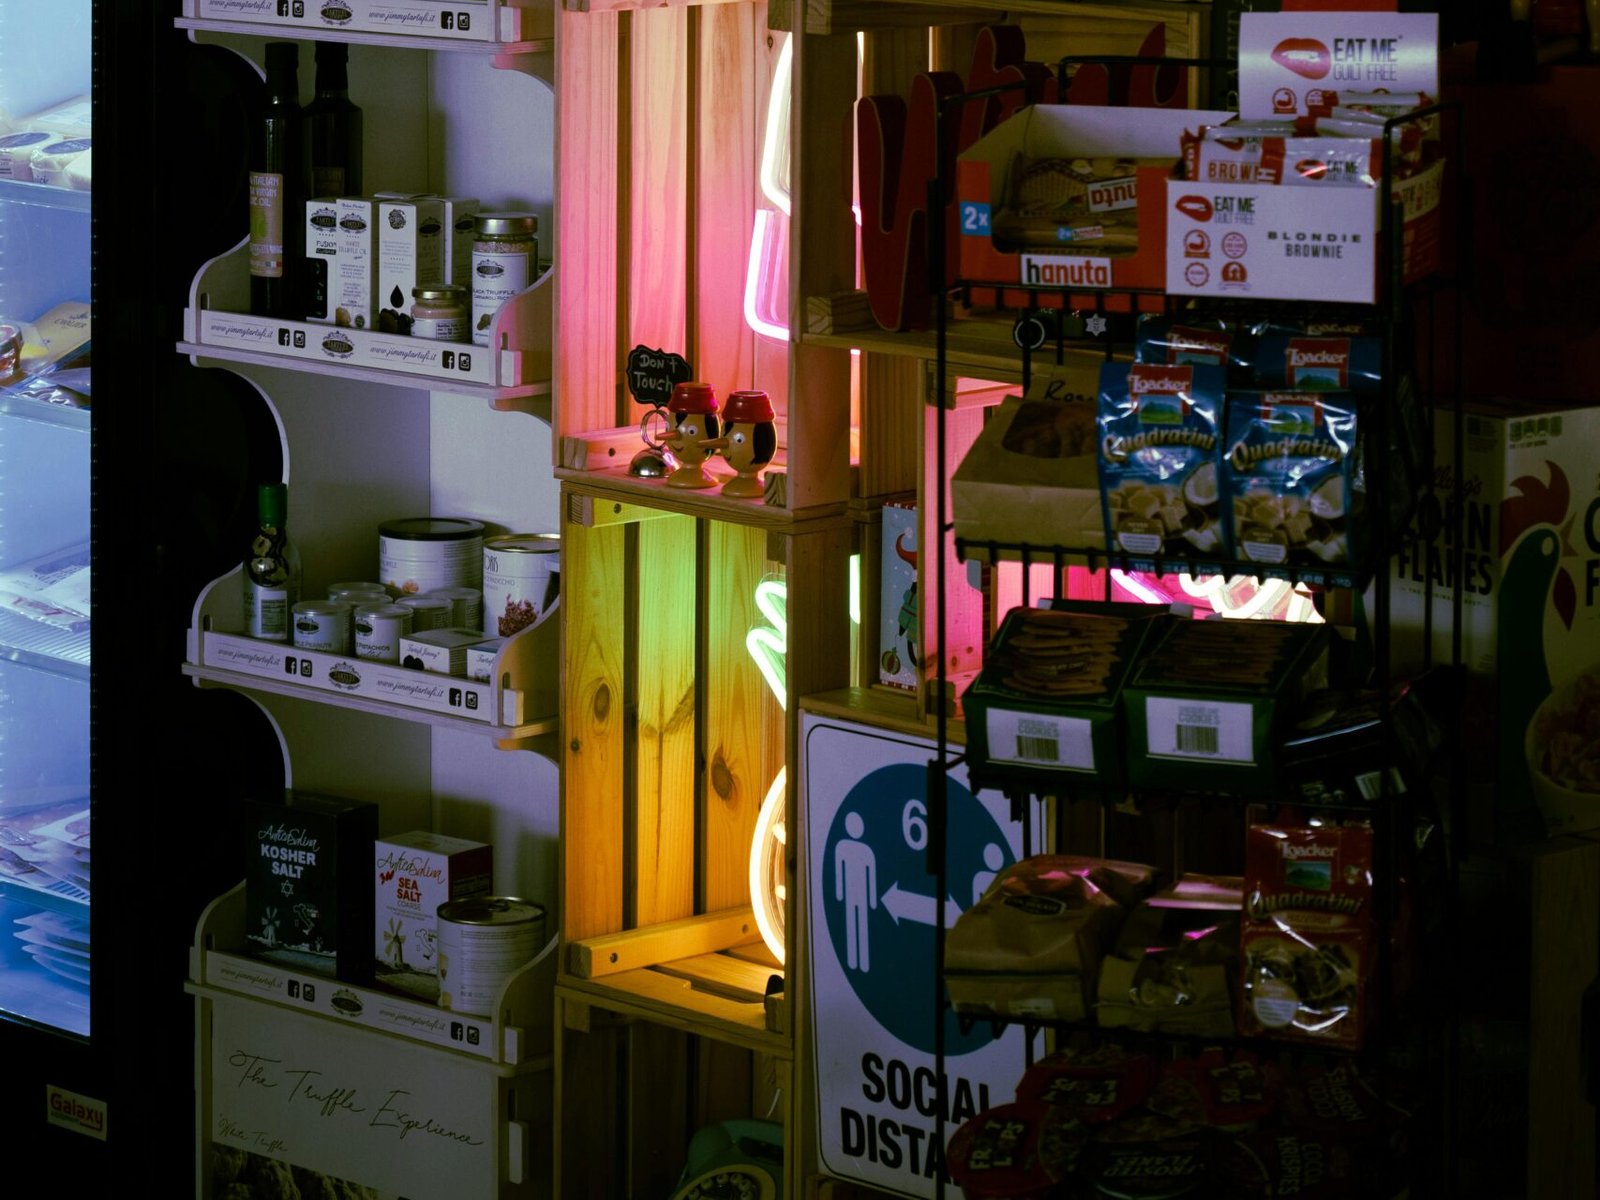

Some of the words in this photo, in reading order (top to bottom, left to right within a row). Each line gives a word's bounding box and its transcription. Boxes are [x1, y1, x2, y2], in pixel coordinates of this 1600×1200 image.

[1334, 38, 1366, 62] EAT
[1371, 38, 1397, 63] ME
[1333, 63, 1363, 81] GUILT
[1367, 63, 1397, 81] FREE
[1214, 196, 1234, 212] EAT
[1237, 196, 1255, 213] ME
[963, 205, 989, 230] 2x
[1267, 231, 1362, 243] BLONDIE
[1285, 243, 1343, 259] BROWNIE
[1026, 257, 1108, 285] hanuta
[1284, 347, 1347, 366] Loacker
[633, 371, 673, 394] Touch
[1127, 373, 1191, 394] Loacker
[1102, 425, 1216, 464] Quadratini
[260, 843, 317, 867] KOSHER
[1275, 840, 1339, 859] Loacker
[271, 860, 304, 880] SALT
[398, 876, 419, 891] SEA
[396, 888, 422, 903] SALT
[1248, 891, 1365, 921] Quadratini
[229, 1050, 281, 1088] The
[285, 1070, 366, 1116] Truffle
[369, 1090, 484, 1146] Experience
[50, 1092, 103, 1130] Galaxy
[841, 1106, 964, 1187] DISTA
